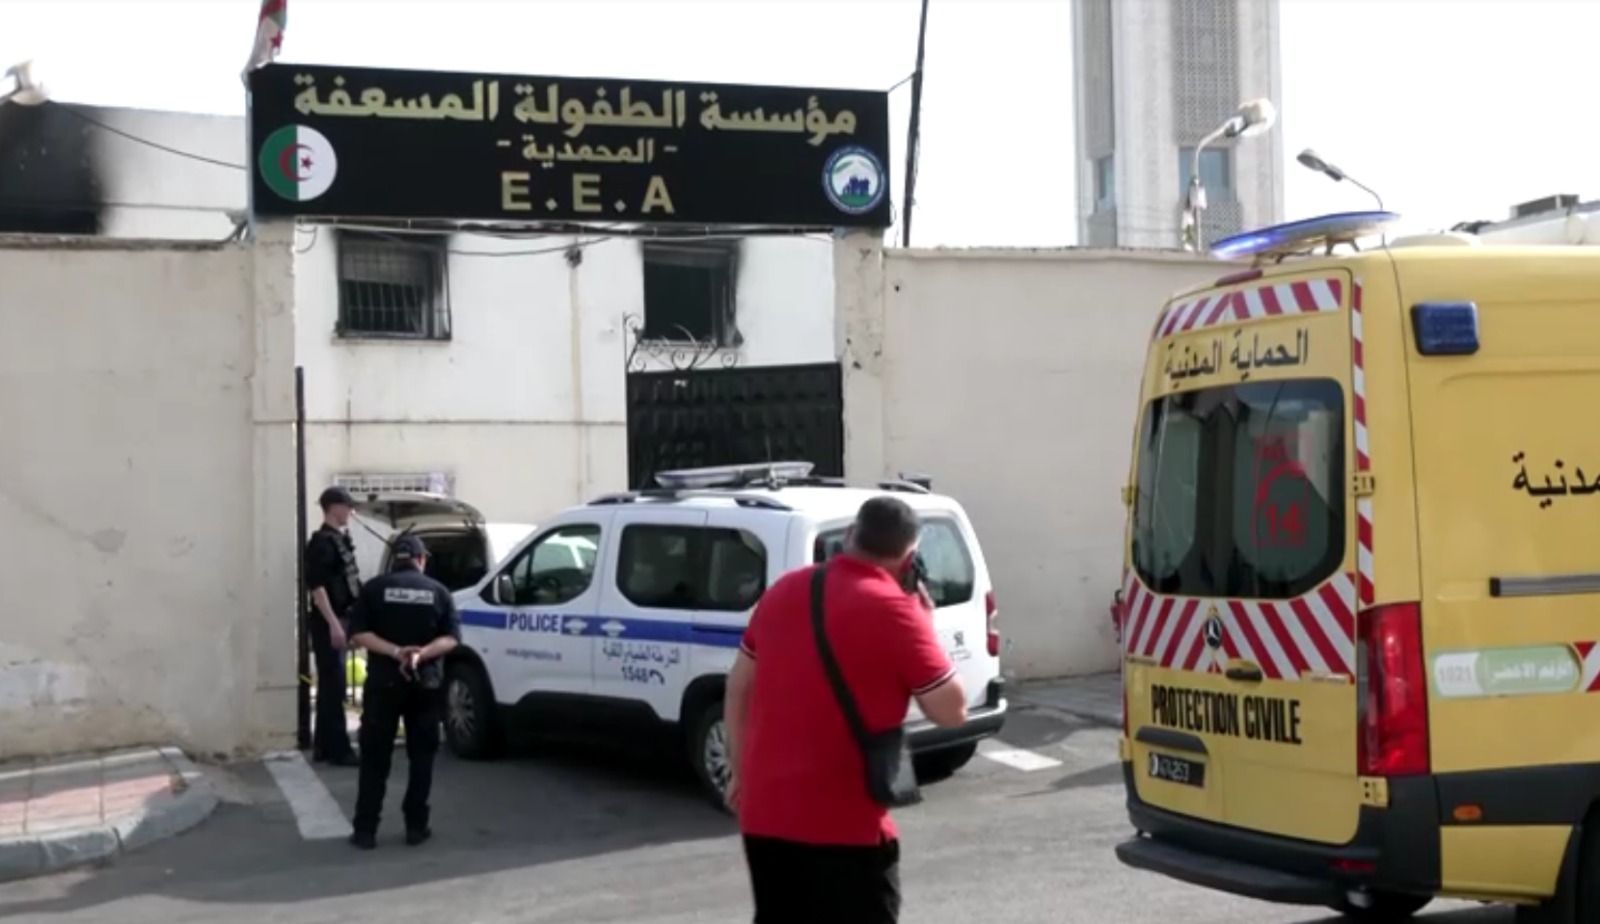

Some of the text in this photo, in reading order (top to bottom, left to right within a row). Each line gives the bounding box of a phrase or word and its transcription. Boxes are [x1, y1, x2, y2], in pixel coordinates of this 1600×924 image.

[294, 74, 857, 146] مؤسسة الطفولة المسعفة
[522, 134, 655, 168] المحمدية
[1165, 327, 1309, 390] الحماية المدنية
[507, 611, 559, 634] POLICE
[621, 664, 649, 685] 1548
[1151, 684, 1303, 745] PROTECTION CIVILE
